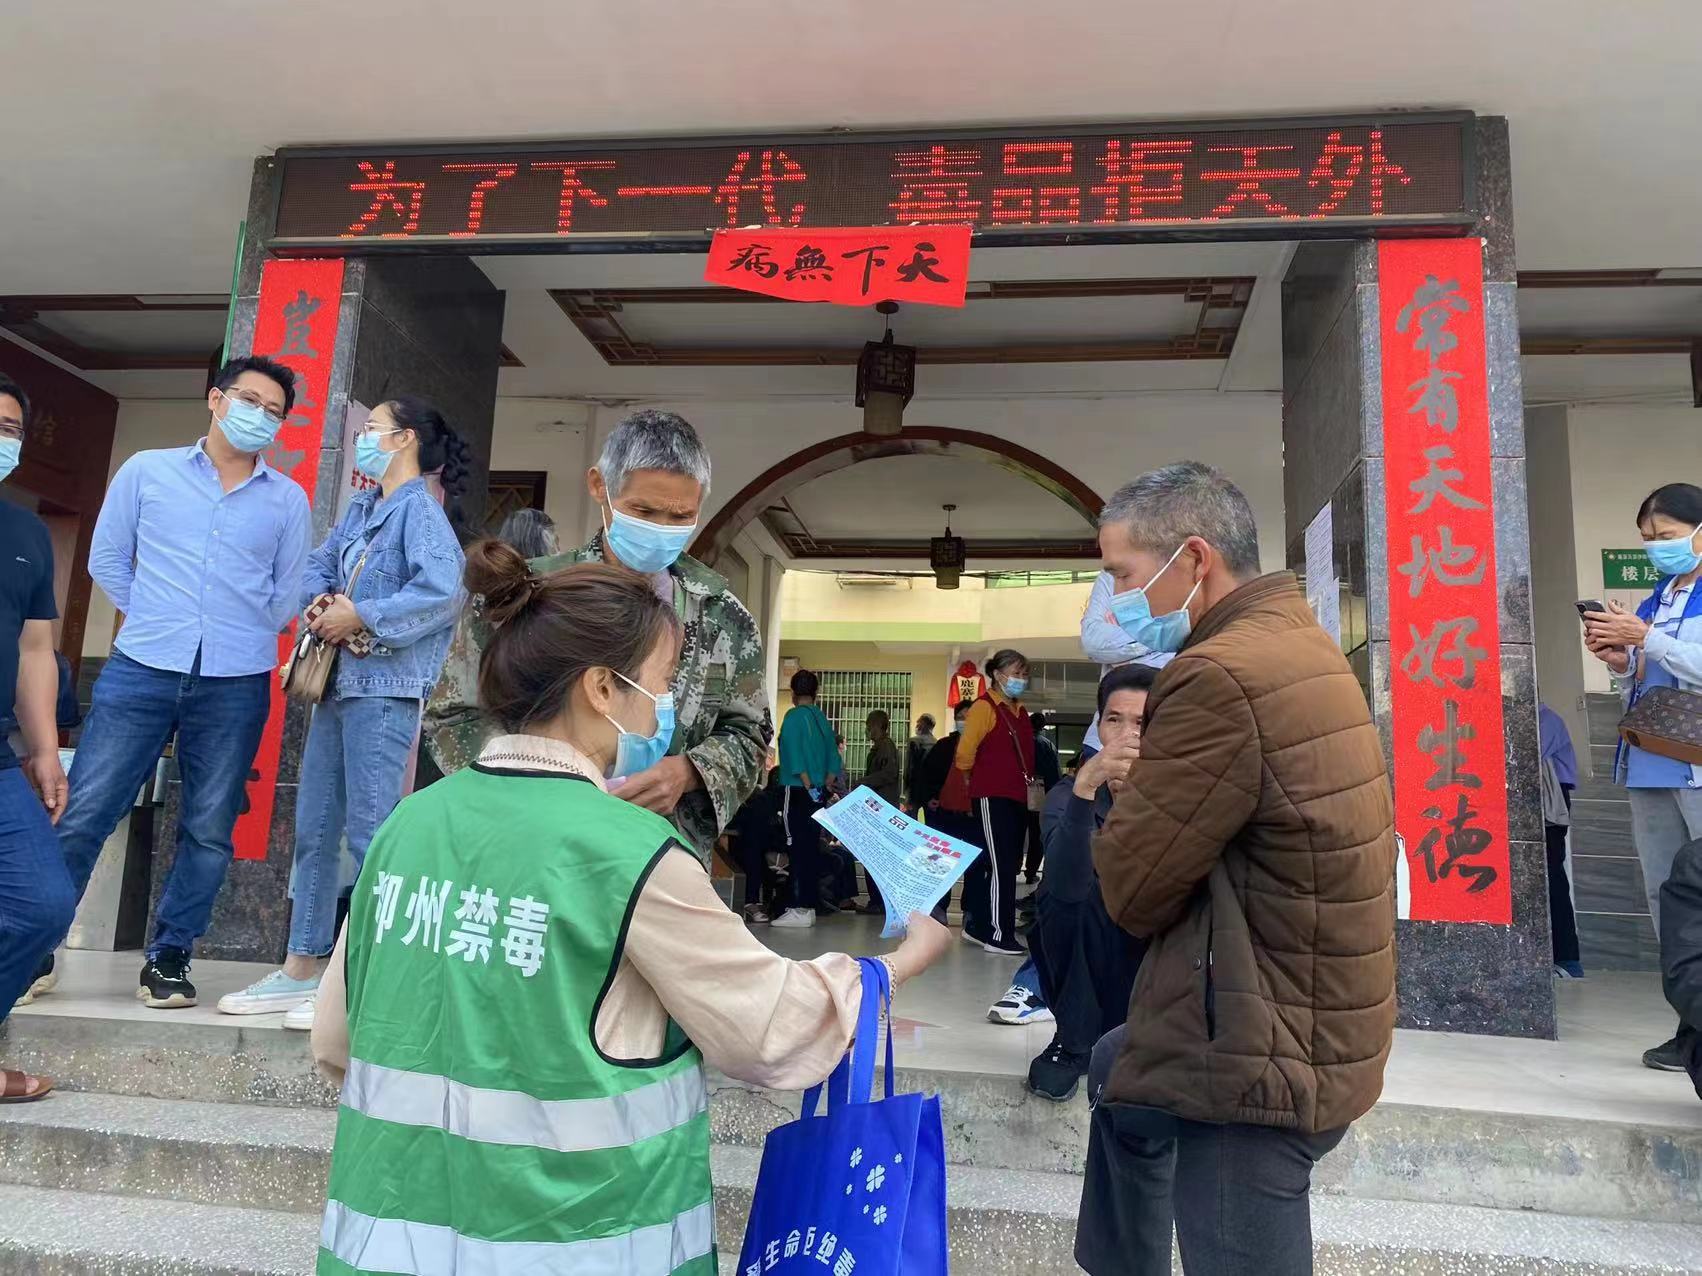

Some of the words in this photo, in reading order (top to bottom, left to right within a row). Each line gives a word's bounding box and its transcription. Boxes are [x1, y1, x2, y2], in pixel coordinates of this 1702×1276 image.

[341, 150, 807, 239] 为了下一代
[889, 129, 1412, 227] 毒品拒天外
[1395, 274, 1498, 894] 常有天地好生德
